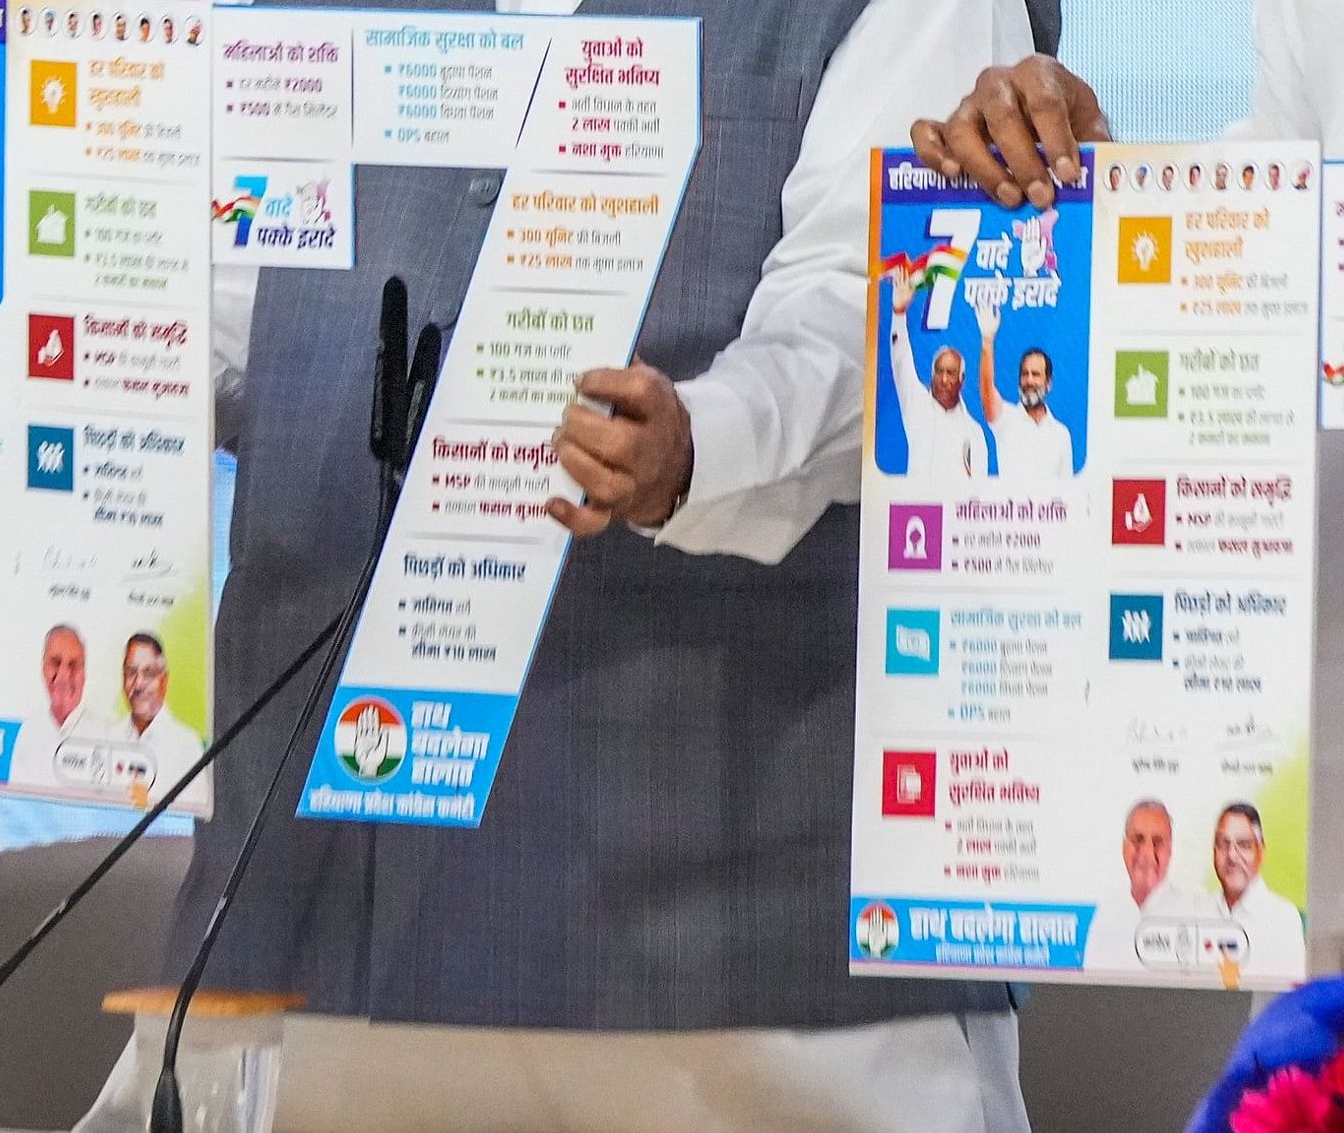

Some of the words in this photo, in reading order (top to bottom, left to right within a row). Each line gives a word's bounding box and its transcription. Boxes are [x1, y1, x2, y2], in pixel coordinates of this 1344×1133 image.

[365, 25, 431, 47] सामाजिक
[435, 29, 475, 54] सुरक्षा
[479, 28, 498, 49] को
[626, 36, 644, 58] को
[233, 174, 269, 248] 7
[265, 193, 294, 219] वादे
[579, 191, 597, 212] को
[925, 207, 982, 331] 7
[976, 231, 1013, 271] वादे
[963, 269, 1012, 308] पक्के
[1012, 269, 1063, 311] इरादे
[550, 307, 568, 331] को
[432, 436, 489, 463] किसानों
[491, 439, 509, 463] को
[1016, 497, 1033, 521] को
[447, 555, 466, 579] को
[992, 747, 1009, 771] को
